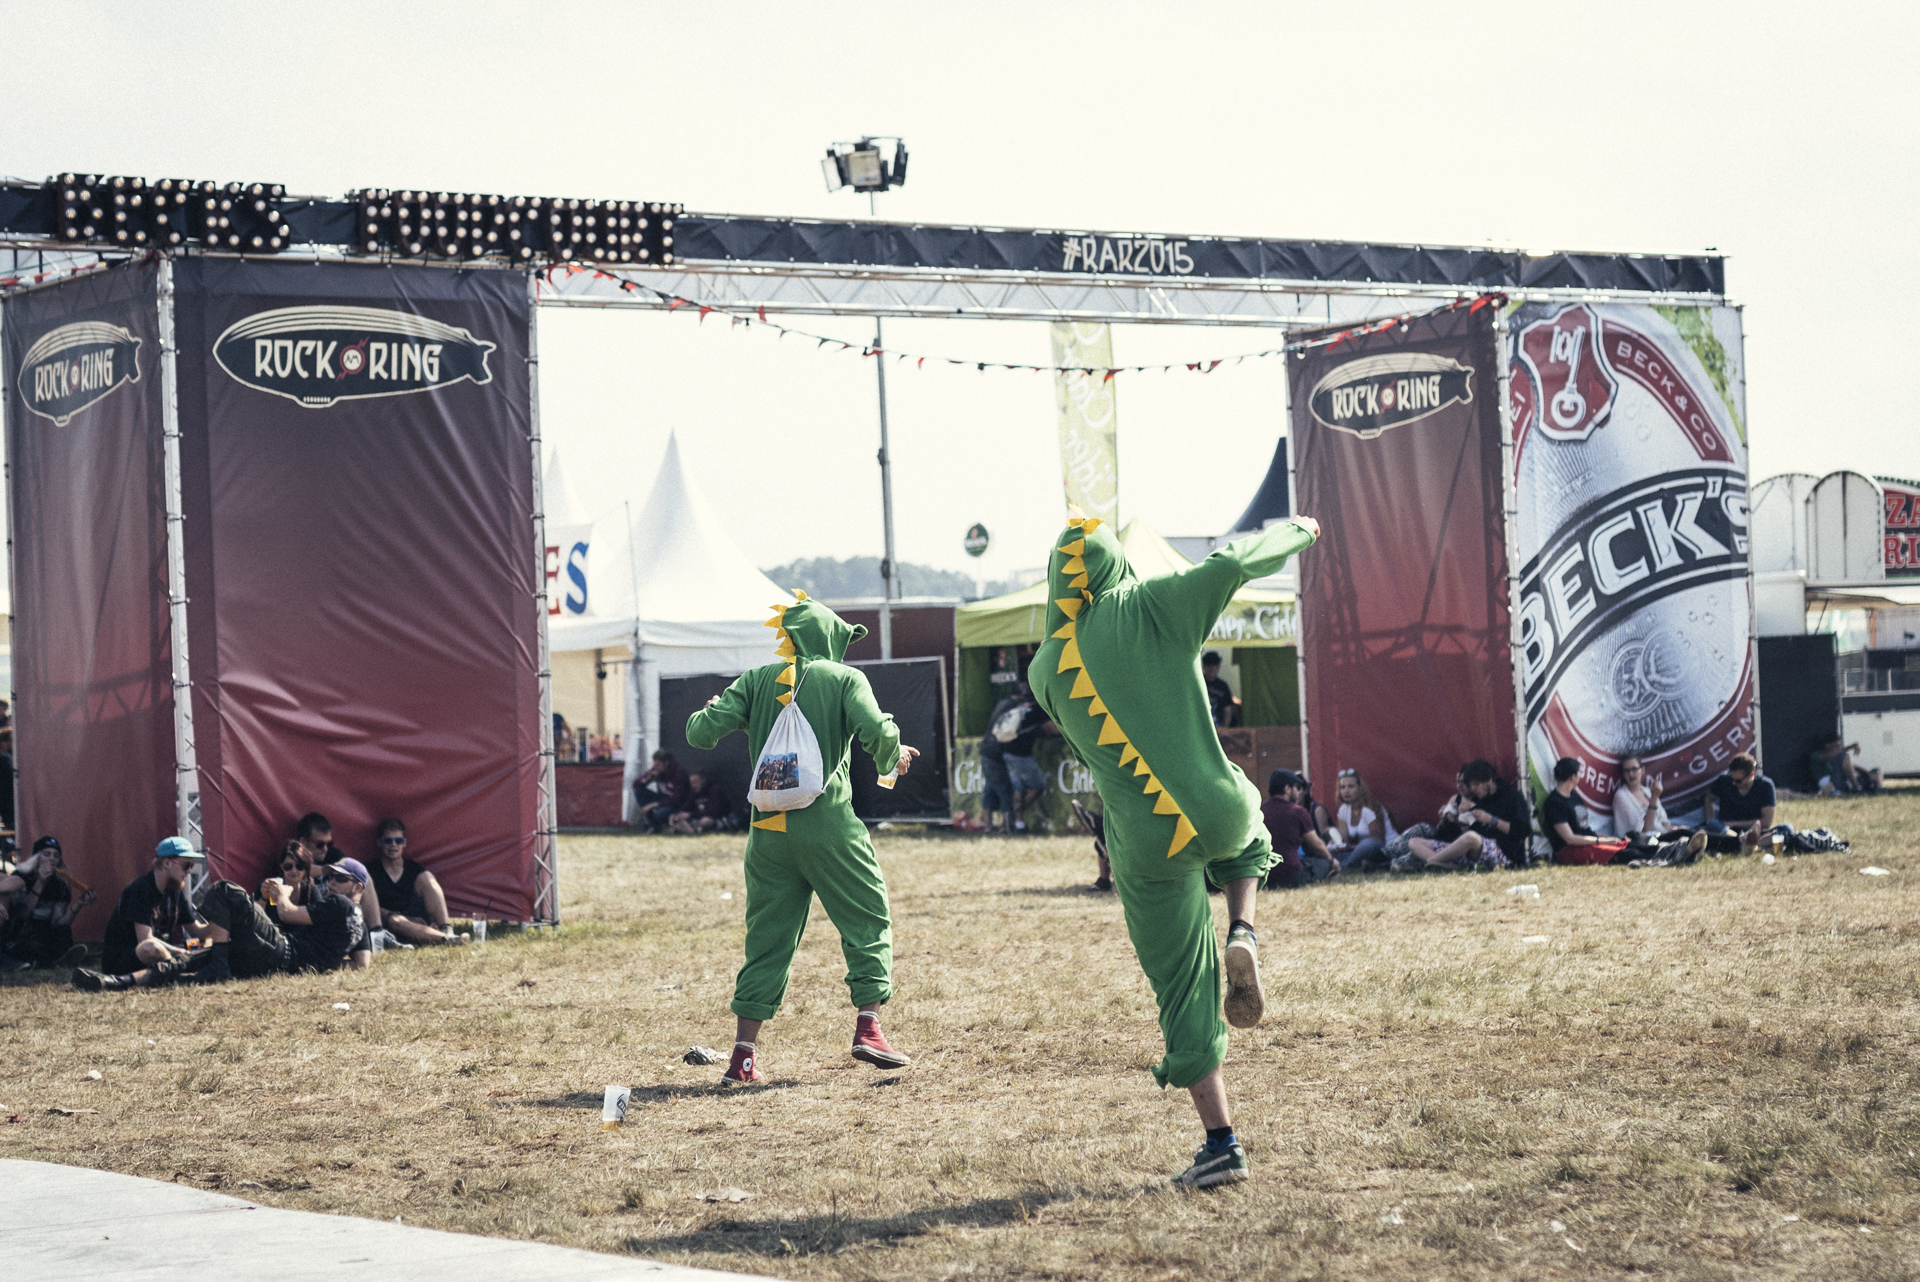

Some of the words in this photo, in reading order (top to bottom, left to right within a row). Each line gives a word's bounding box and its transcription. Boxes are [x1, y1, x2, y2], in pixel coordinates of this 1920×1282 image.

[57, 173, 289, 249] BECKS
[1062, 237, 1195, 274] #RAR2015
[35, 359, 69, 402] ROCK
[81, 348, 114, 392] RING
[255, 339, 337, 379] ROCK
[369, 342, 443, 382] RING
[1332, 383, 1380, 420] ROCK
[1397, 374, 1442, 411] RING
[1616, 341, 1675, 394] BECK
[1690, 413, 1717, 451] CO
[1577, 756, 1663, 795] BREMN
